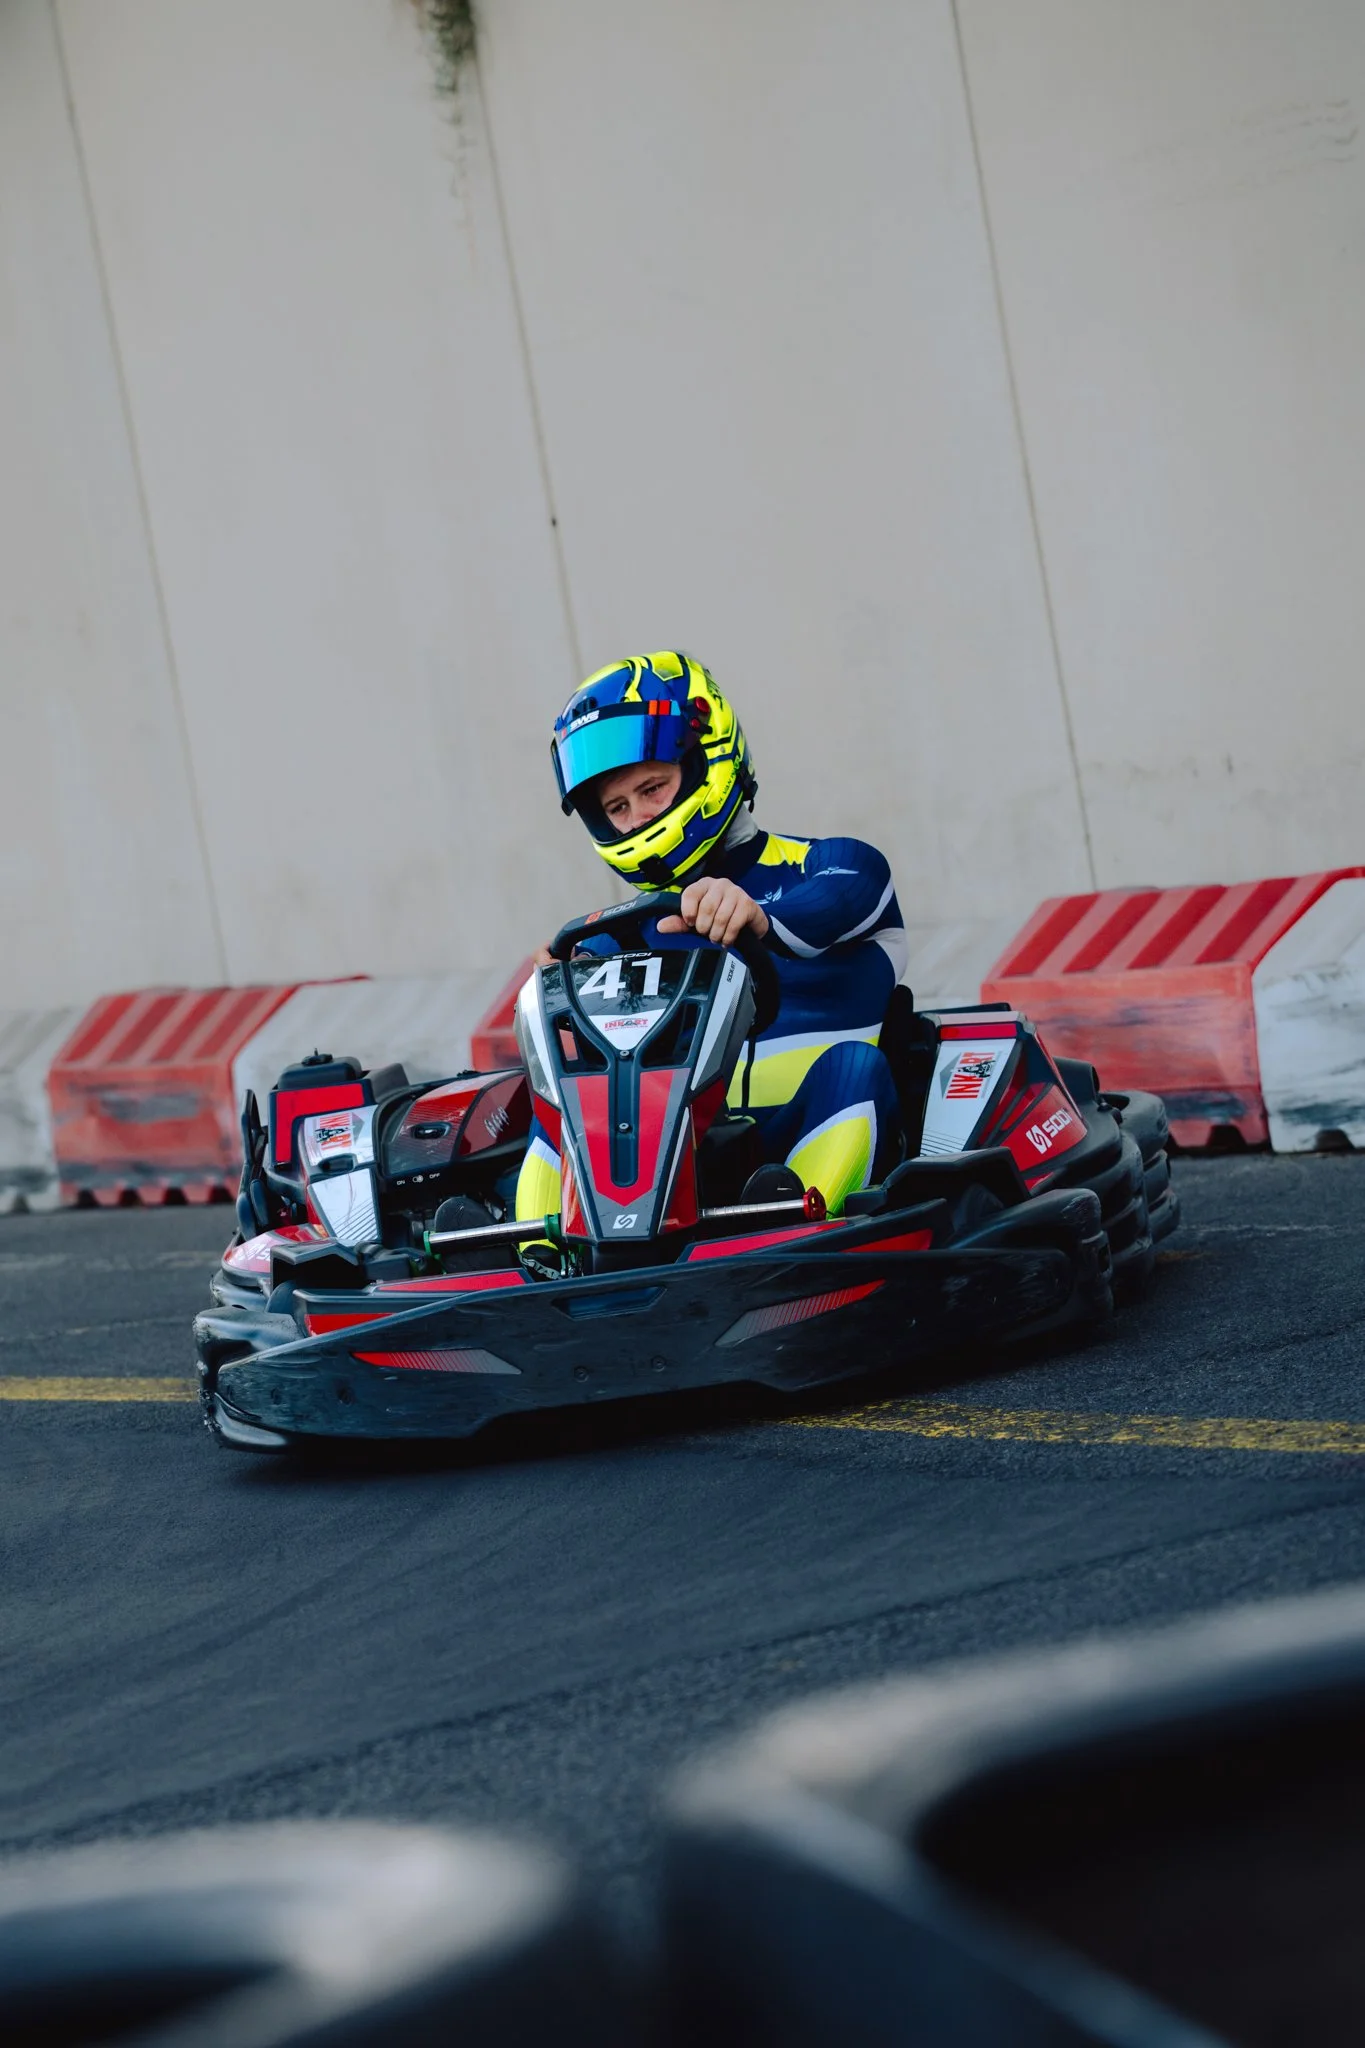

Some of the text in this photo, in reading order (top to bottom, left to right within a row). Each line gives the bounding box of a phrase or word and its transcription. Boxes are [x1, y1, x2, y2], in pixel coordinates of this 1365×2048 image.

[602, 901, 637, 918] SODI
[612, 952, 652, 960] SODI
[578, 957, 663, 1000] 41
[1041, 1107, 1073, 1139] SODI
[429, 1172, 441, 1180] OFF
